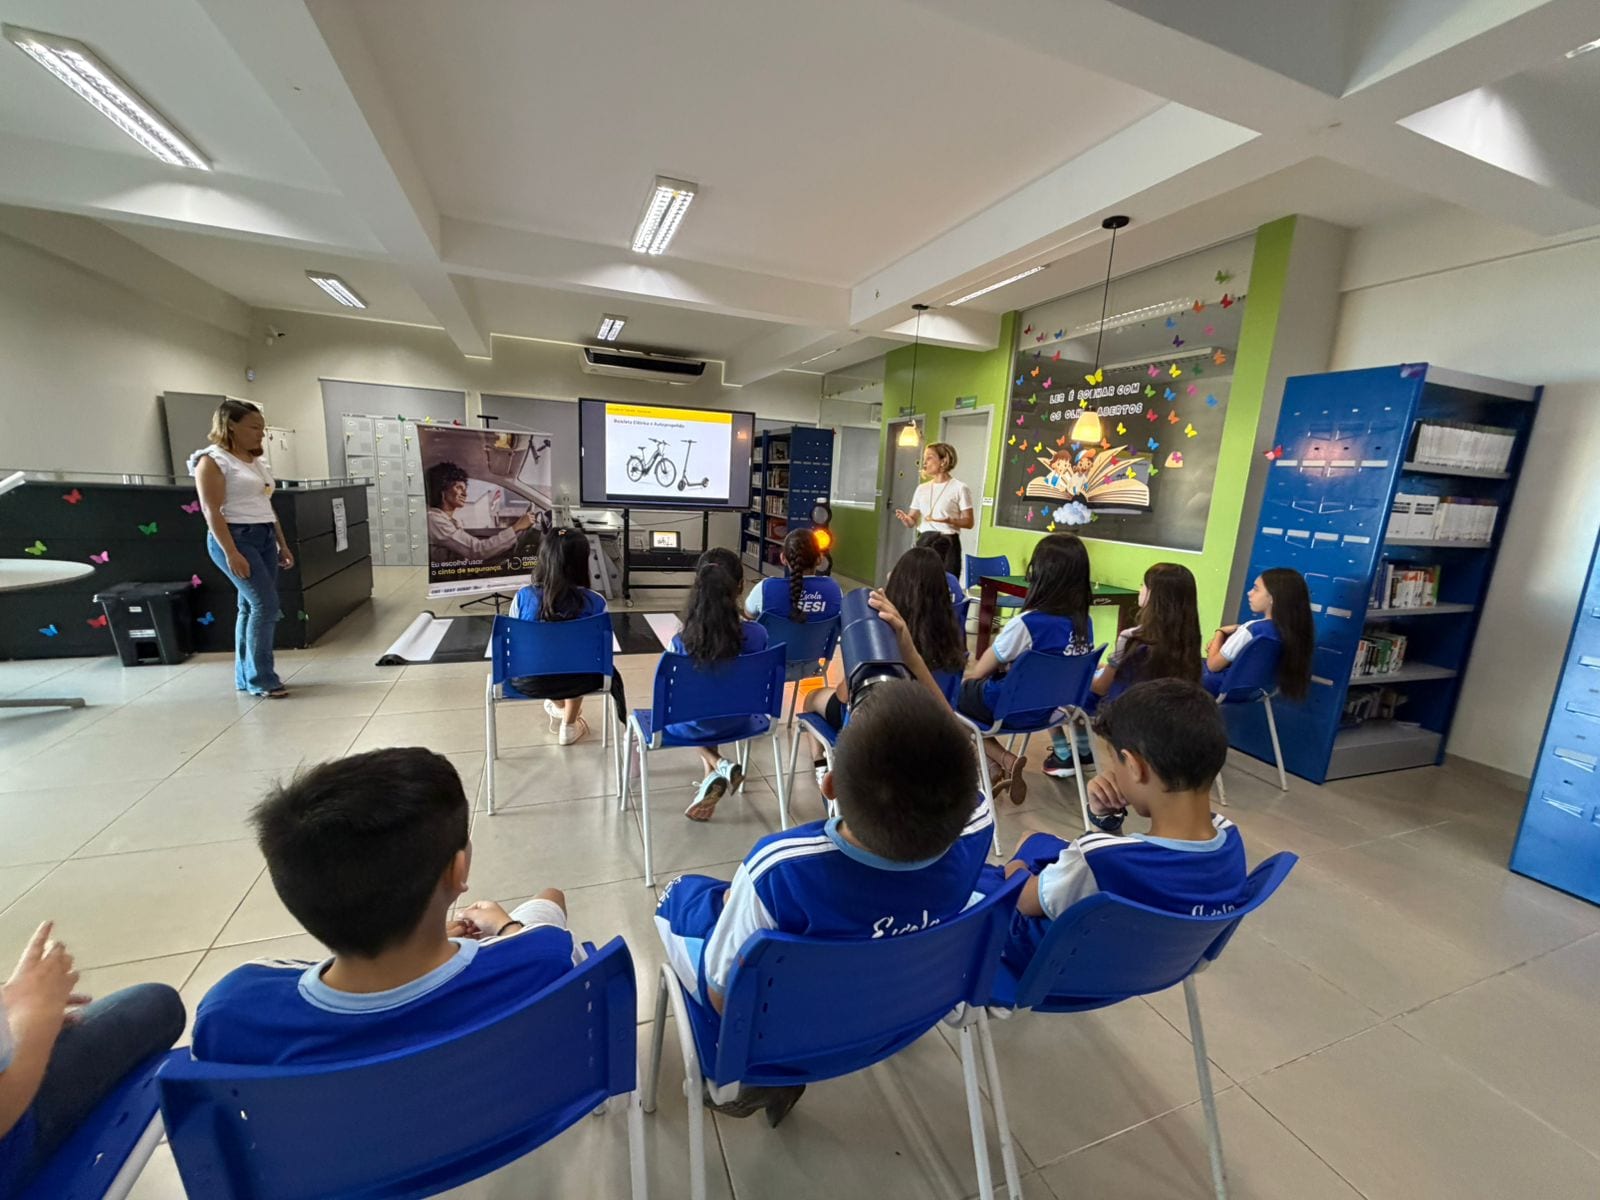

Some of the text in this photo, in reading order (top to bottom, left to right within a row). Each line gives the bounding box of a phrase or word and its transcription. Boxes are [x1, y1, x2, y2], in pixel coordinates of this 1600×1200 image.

[1050, 393, 1065, 404] LER
[1117, 382, 1140, 395] COM
[1050, 411, 1061, 421] OS
[1097, 403, 1143, 417] ABERTOS
[797, 601, 826, 613] SESI
